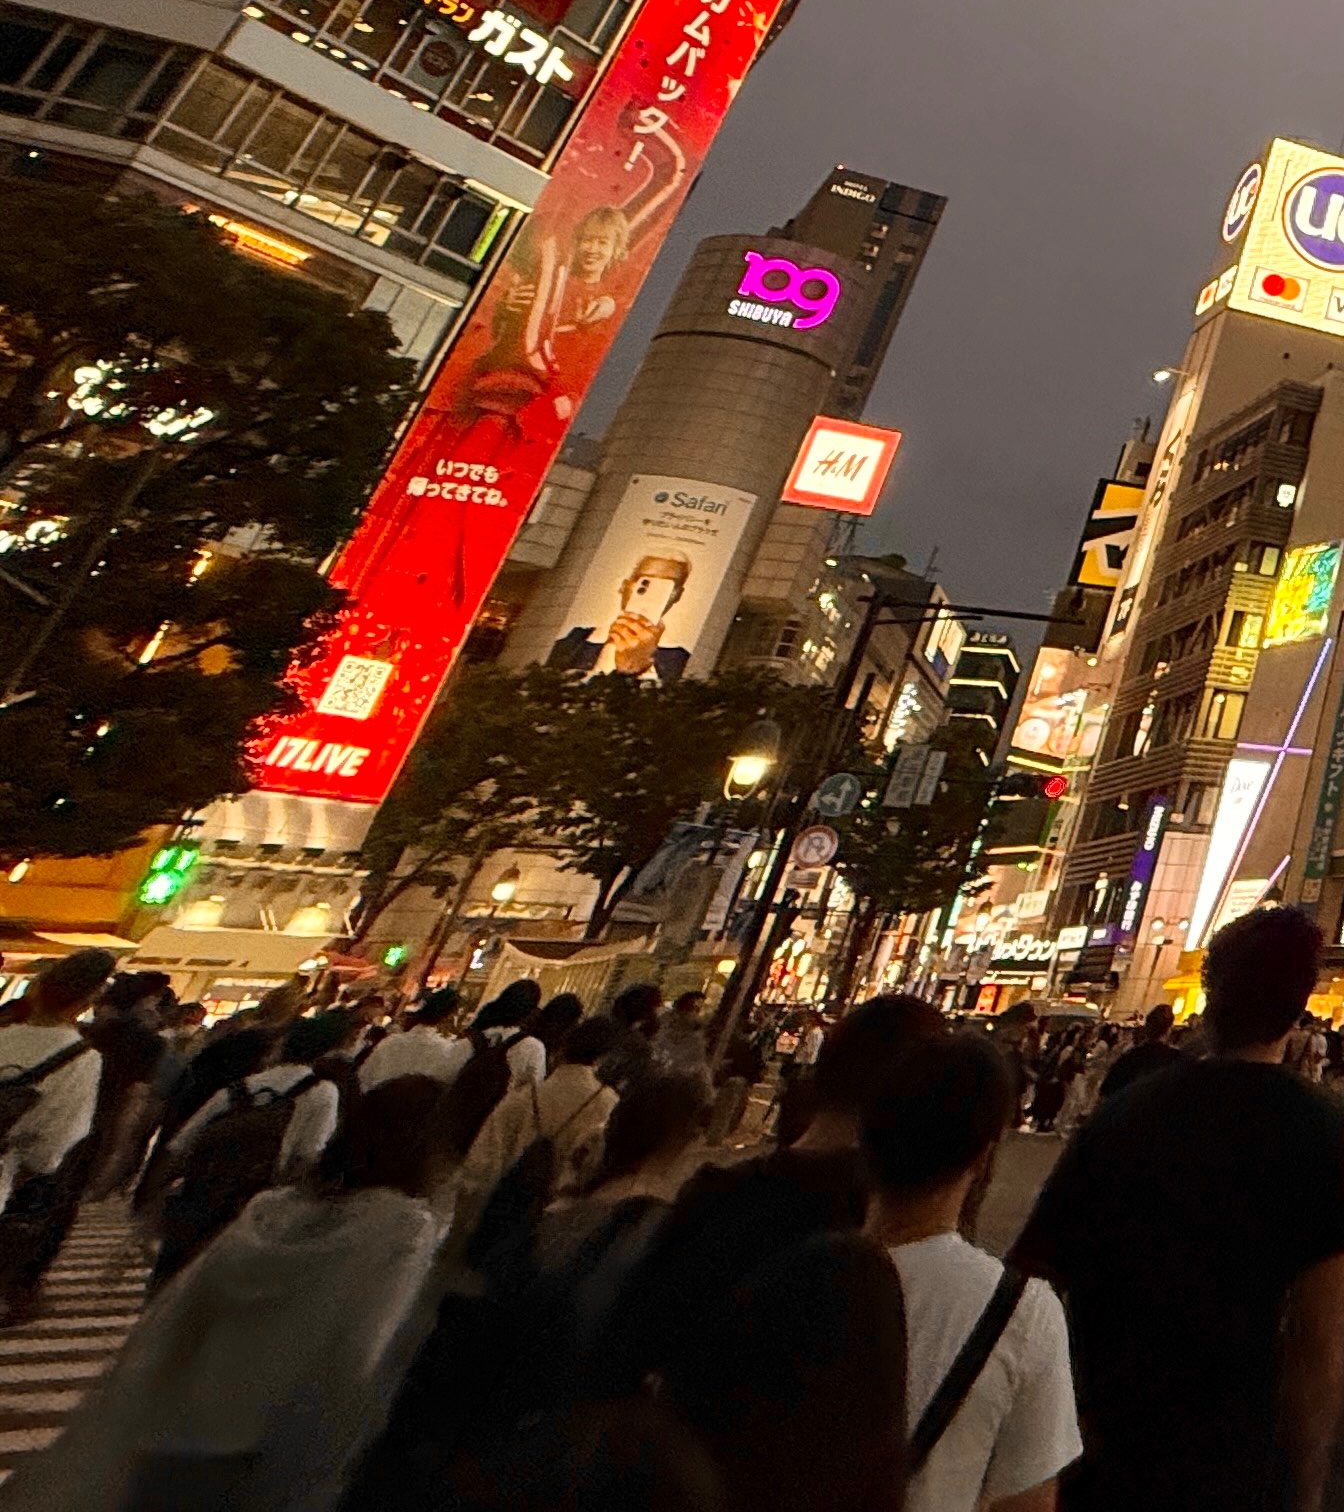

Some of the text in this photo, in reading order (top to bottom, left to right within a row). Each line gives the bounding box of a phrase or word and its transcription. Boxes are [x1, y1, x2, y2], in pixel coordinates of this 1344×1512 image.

[466, 8, 575, 85] ガスト
[830, 183, 877, 204] INDIGO
[744, 250, 841, 331] 109
[727, 299, 793, 328] SHIBUYA
[435, 457, 500, 484] いつでも
[812, 449, 869, 482] H&M
[670, 491, 729, 517] Safari
[265, 736, 371, 778] 17LIVE
